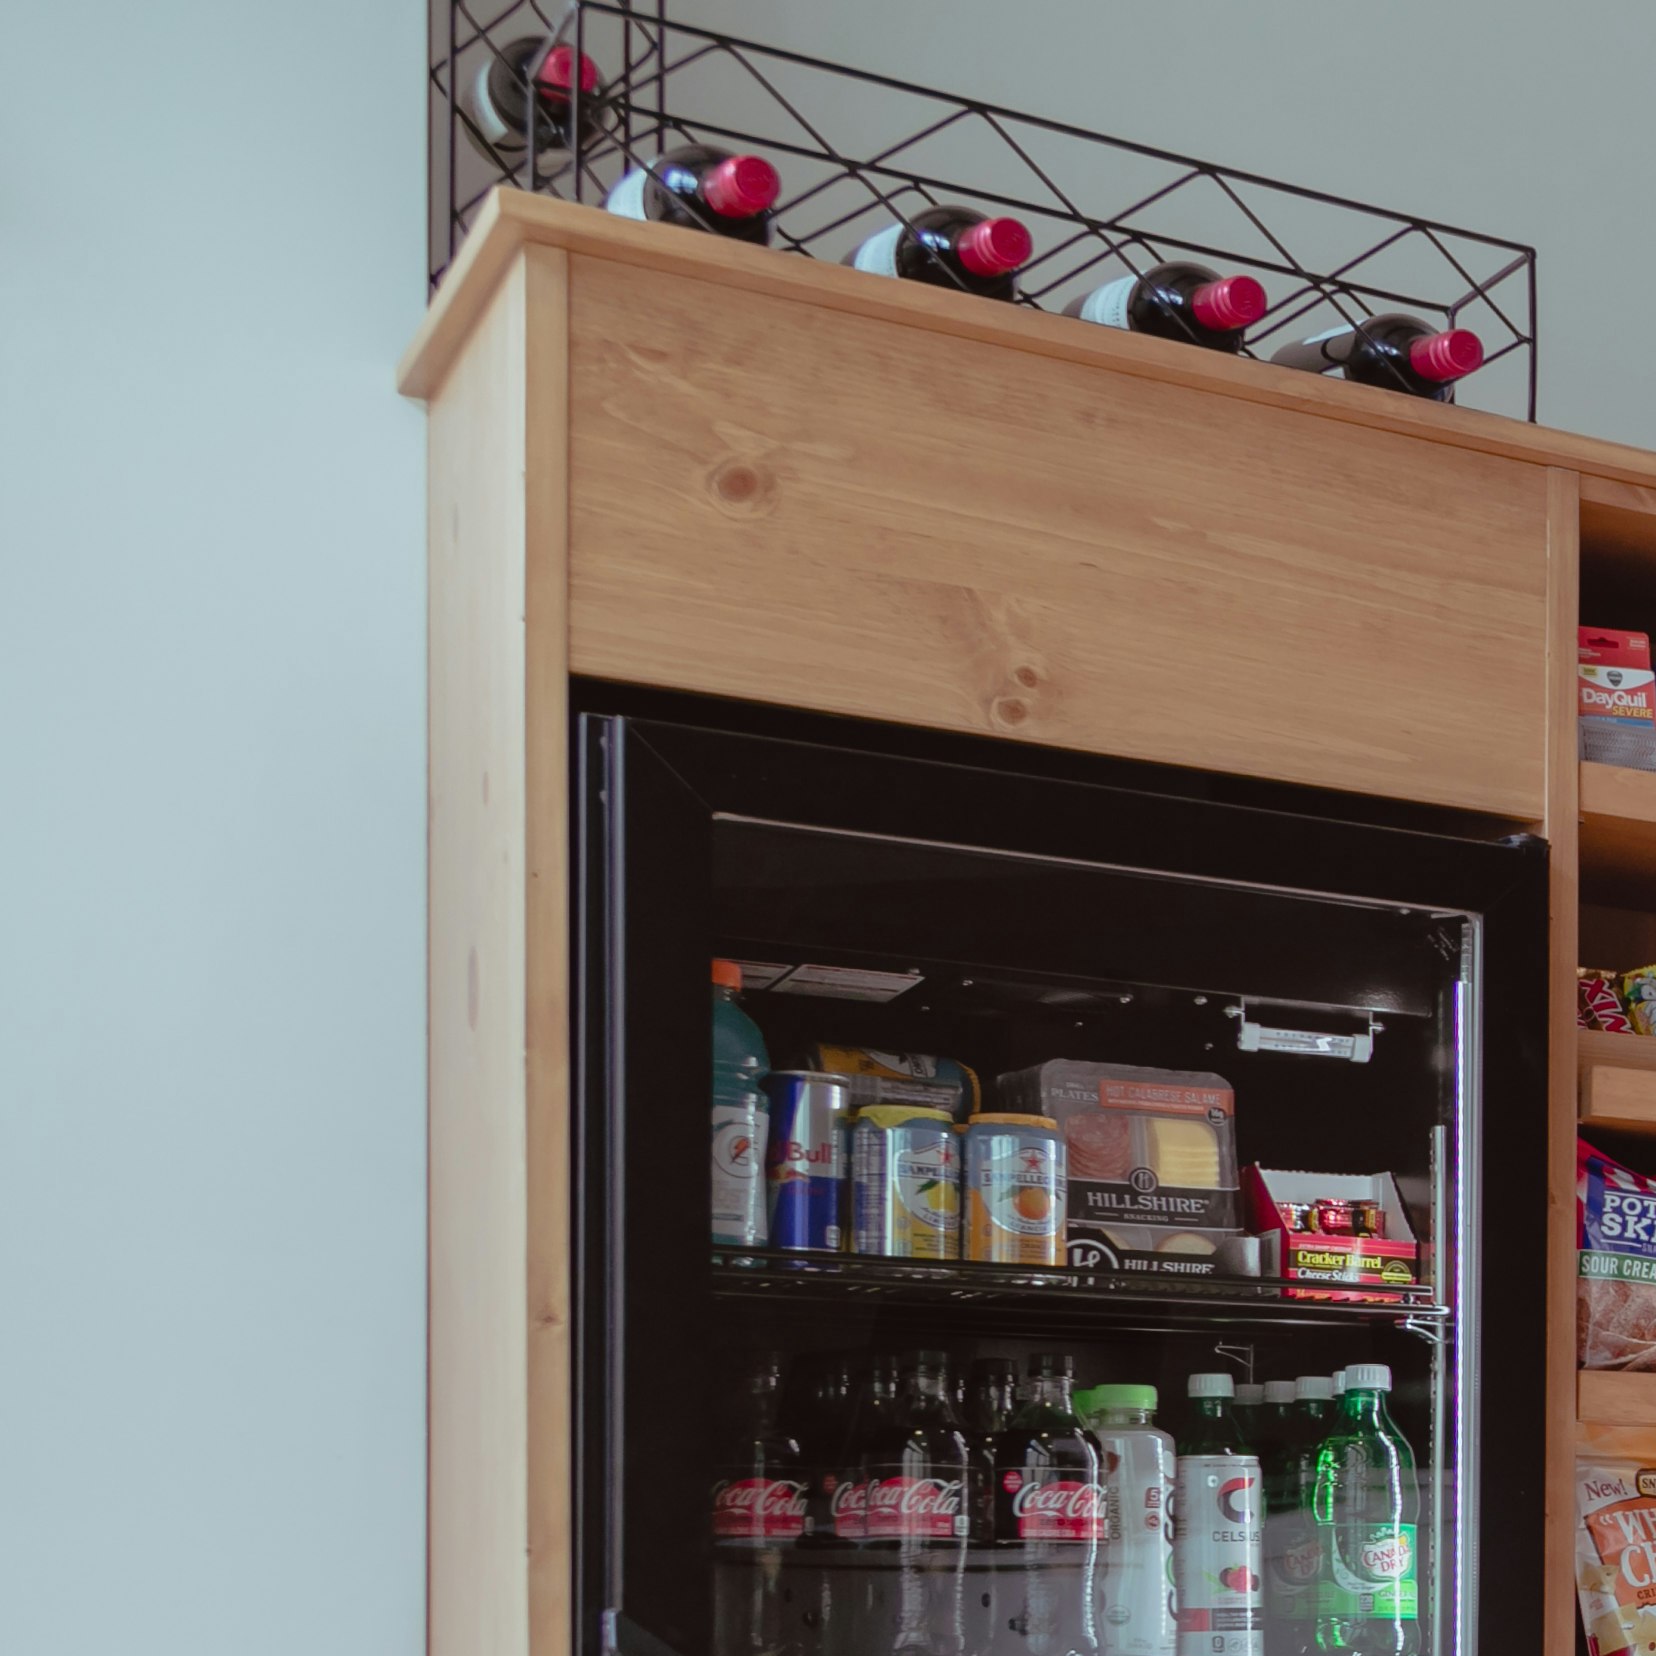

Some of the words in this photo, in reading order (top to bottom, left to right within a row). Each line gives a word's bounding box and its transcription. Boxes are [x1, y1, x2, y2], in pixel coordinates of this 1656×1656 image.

[1581, 687, 1647, 709] DayQuil
[1612, 705, 1654, 718] SEVERE
[1579, 978, 1636, 1035] WIX
[1051, 1087, 1099, 1101] PLATES
[1106, 1086, 1126, 1098] HOT
[1128, 1087, 1183, 1104] CALABRESE
[1184, 1092, 1222, 1106] SALAME
[787, 1141, 833, 1165] Bull
[1087, 1191, 1206, 1214] HILLSHIRE
[1123, 1213, 1169, 1222] SNACKING
[1297, 1250, 1345, 1268] Cracker
[1345, 1252, 1382, 1269] Barrel
[1581, 1255, 1619, 1275] SOUR
[1297, 1268, 1332, 1281] Cheese
[865, 1478, 964, 1515] Coca-Cola
[1584, 1478, 1628, 1501] New!
[1109, 1485, 1120, 1541] ORGANIC
[1212, 1530, 1260, 1543] CELSUS
